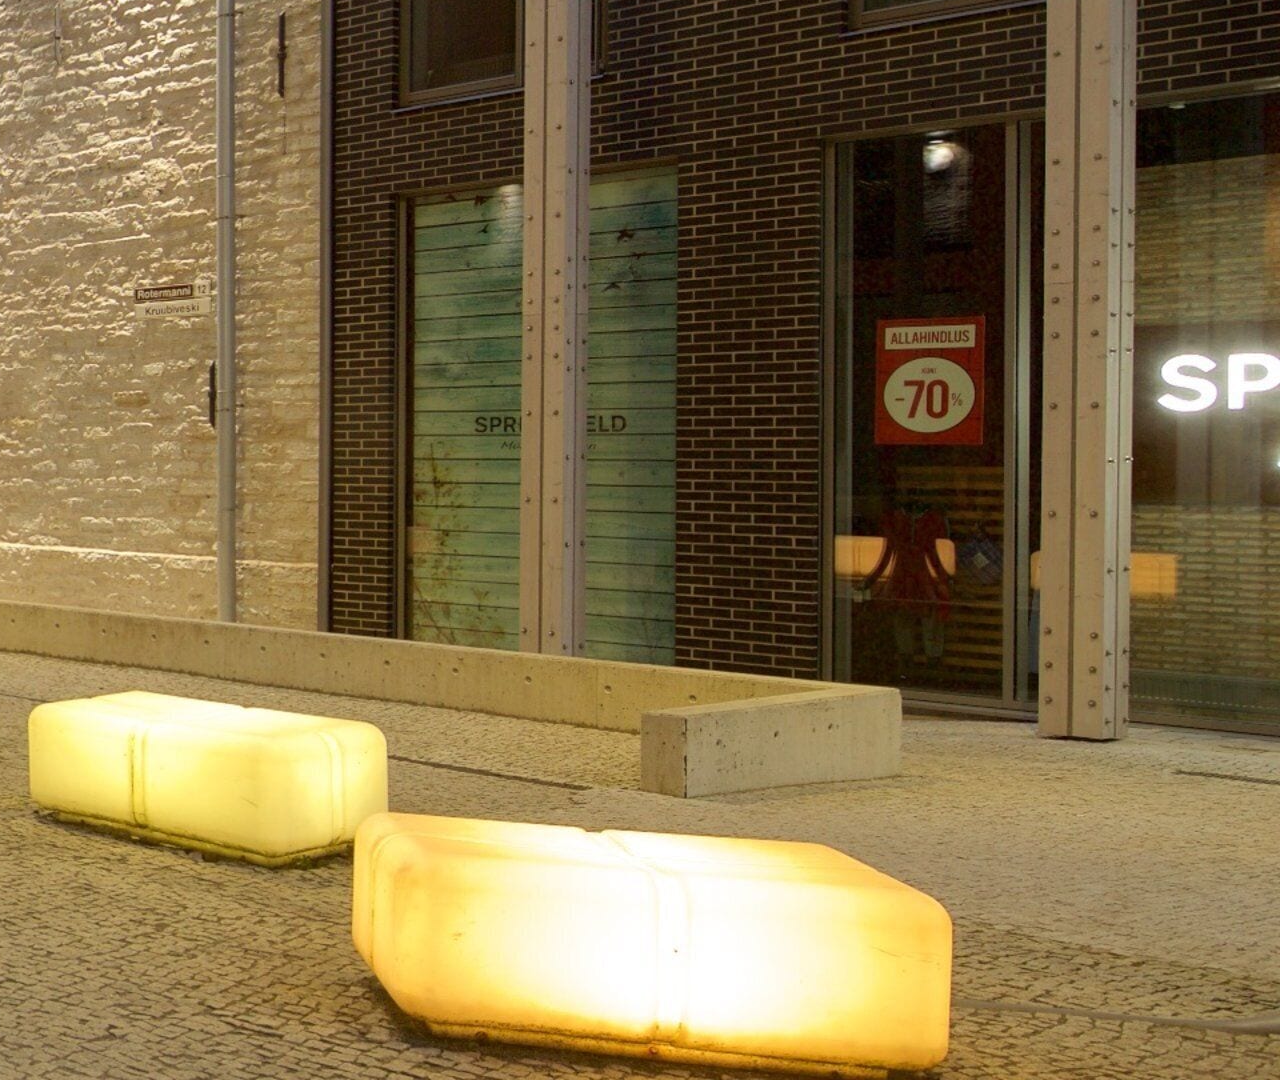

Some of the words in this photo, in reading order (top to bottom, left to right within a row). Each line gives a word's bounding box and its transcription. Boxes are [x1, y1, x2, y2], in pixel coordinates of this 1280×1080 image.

[137, 287, 191, 300] Rotermanni
[198, 284, 207, 294] 12
[145, 303, 200, 316] Kruubiveski
[890, 330, 971, 345] ALLAHINDLUS
